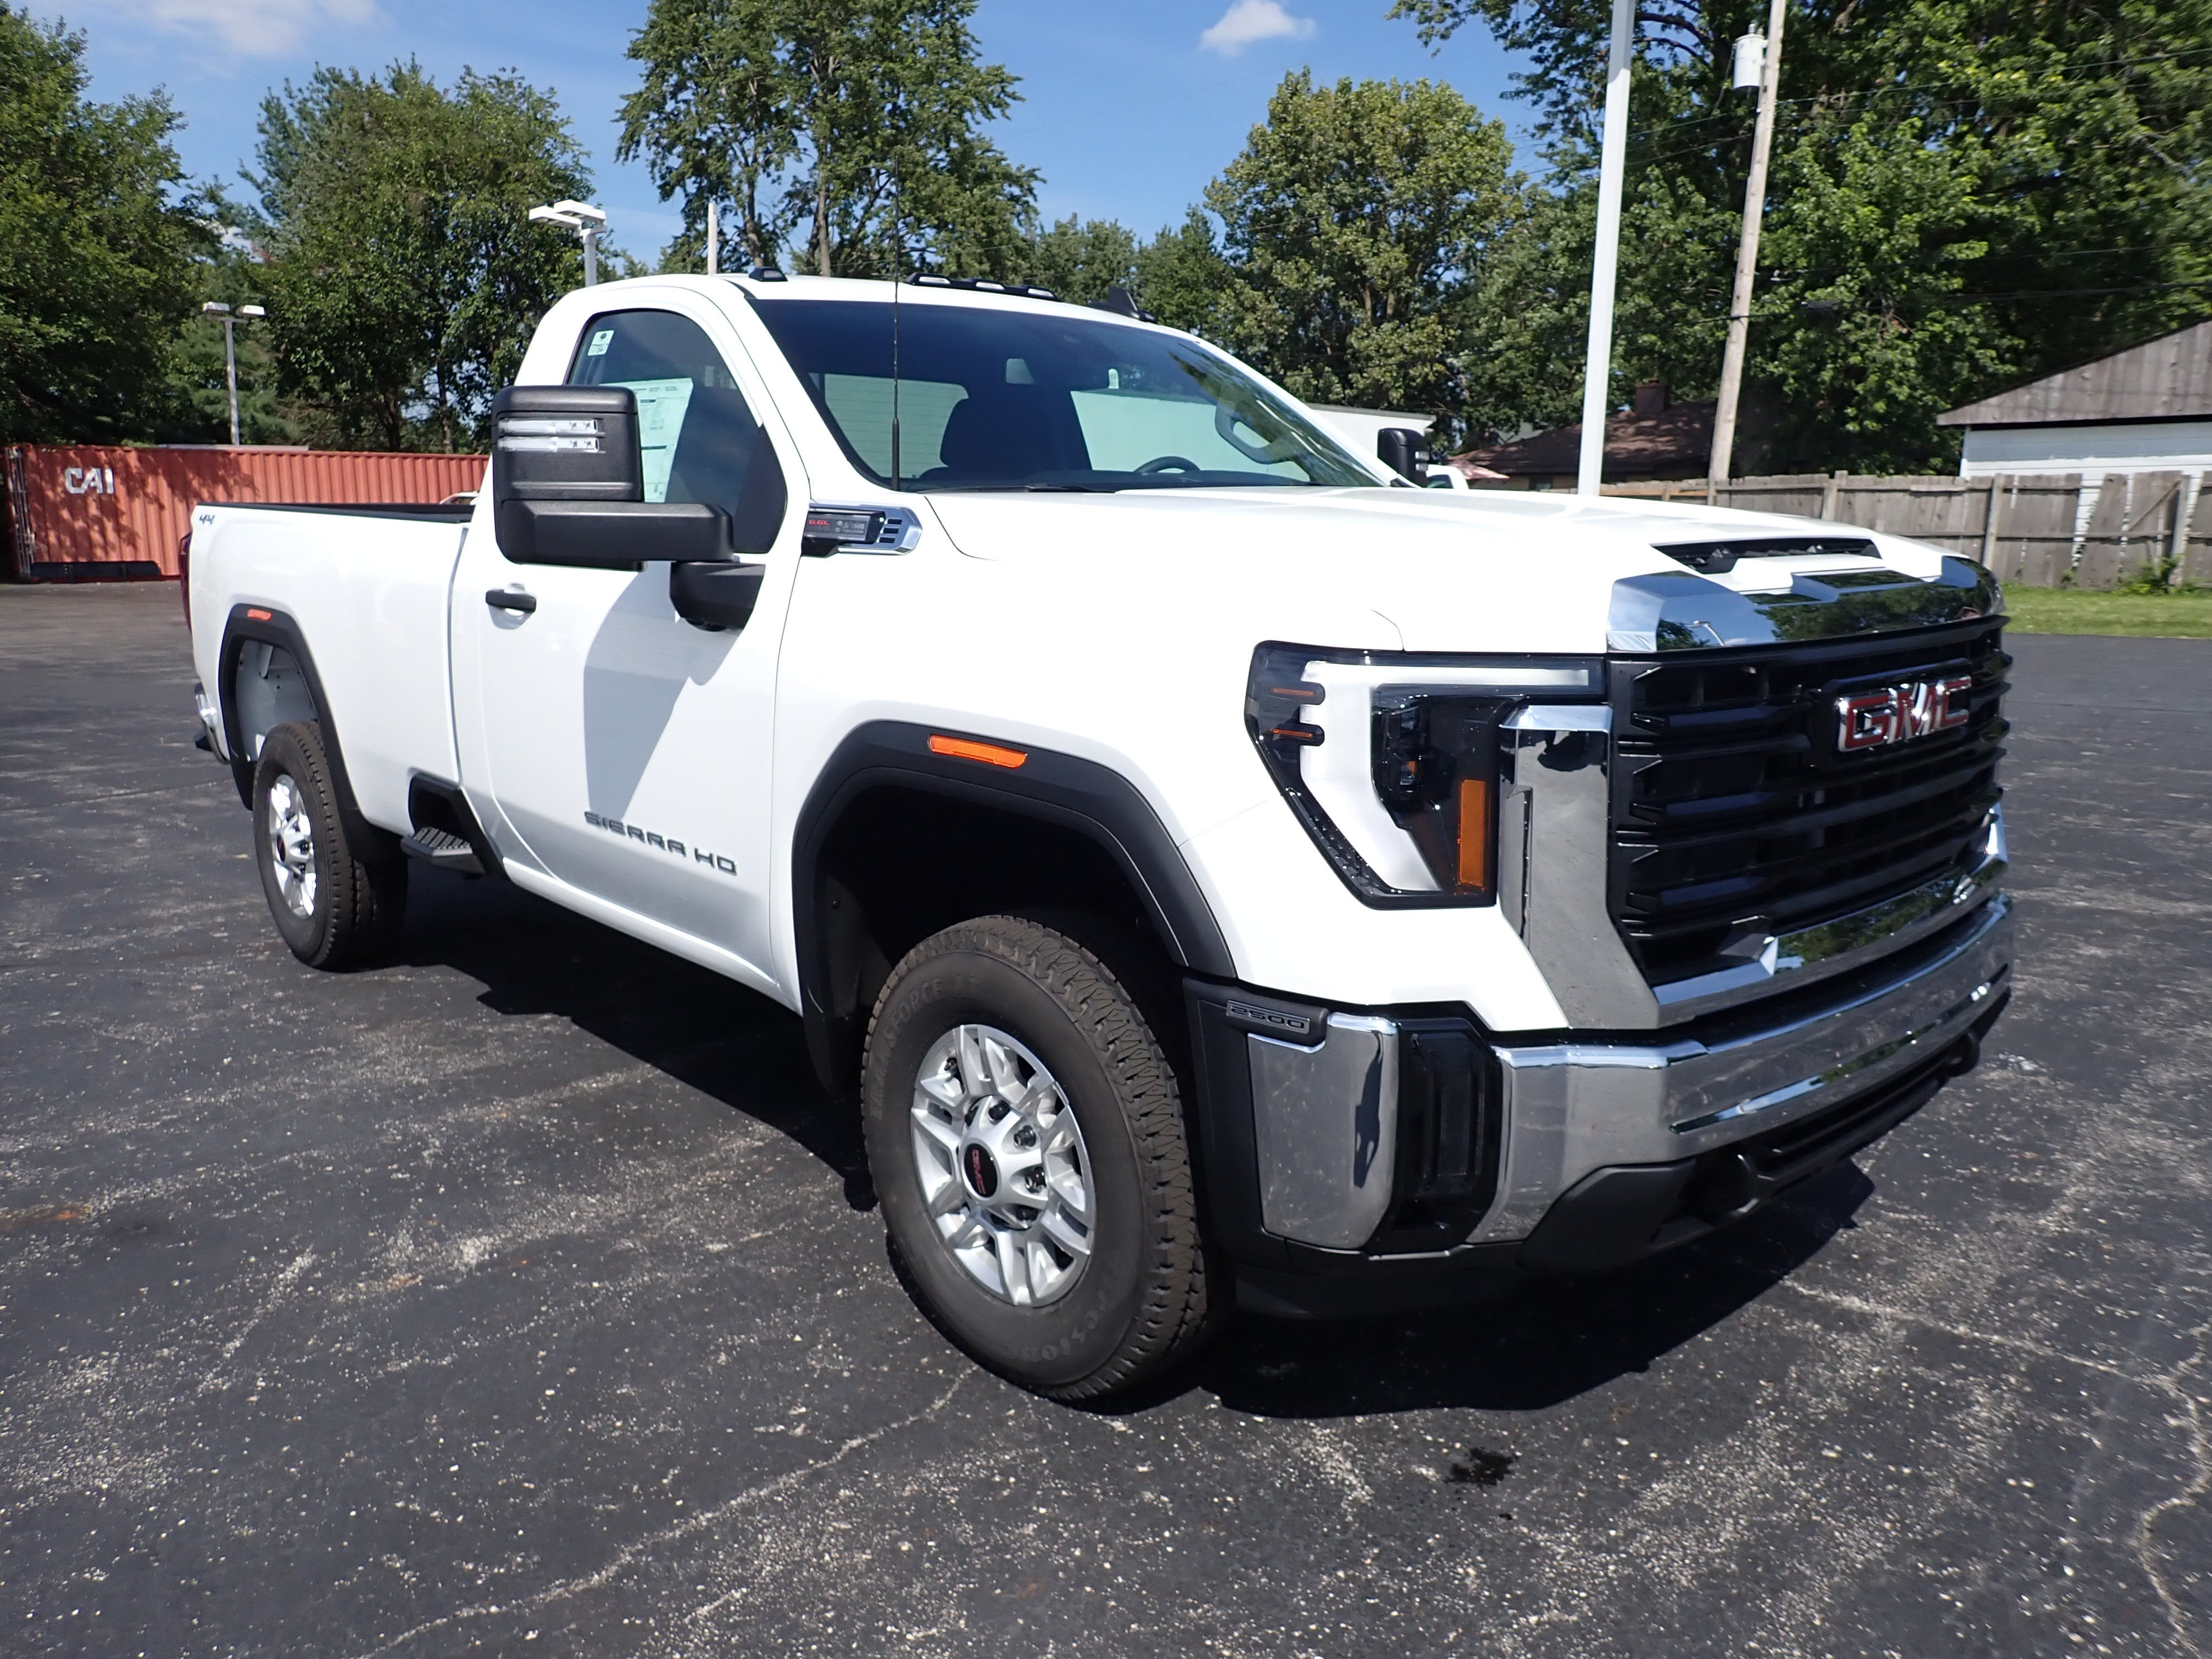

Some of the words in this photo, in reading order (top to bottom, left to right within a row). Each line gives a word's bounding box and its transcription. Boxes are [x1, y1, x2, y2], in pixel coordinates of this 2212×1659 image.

[65, 467, 114, 494] CAI
[1835, 674, 1973, 753] GMC
[584, 811, 687, 857] SIERRA
[695, 847, 737, 877] HD
[1229, 1005, 1305, 1029] 2500
